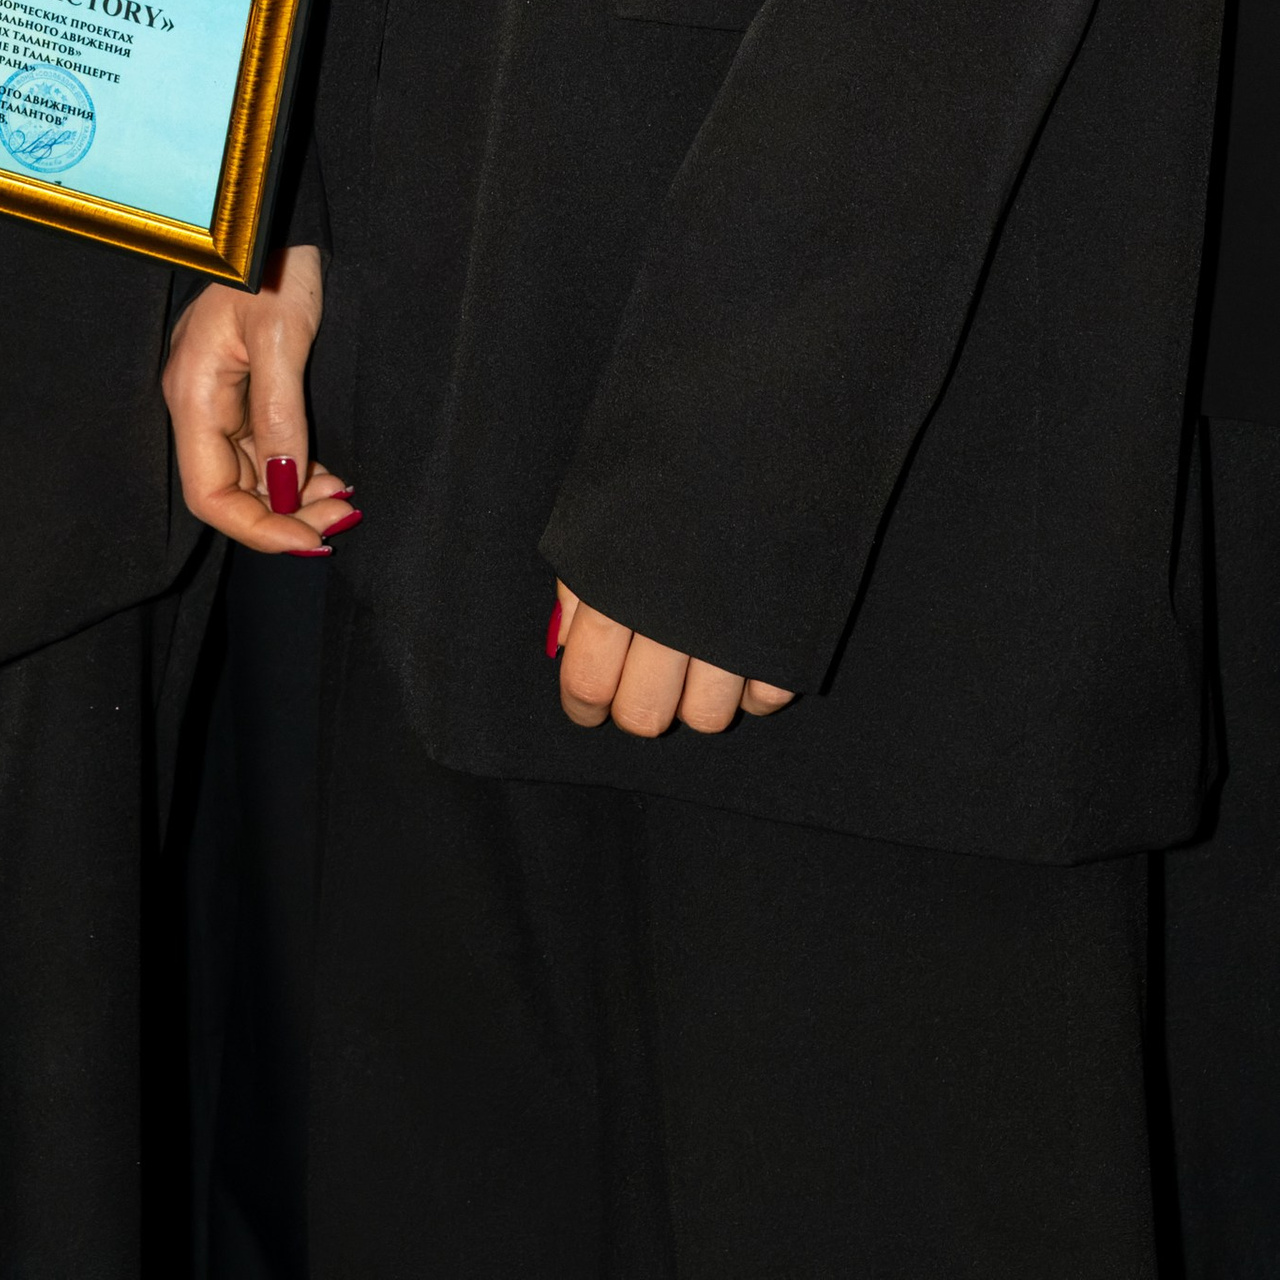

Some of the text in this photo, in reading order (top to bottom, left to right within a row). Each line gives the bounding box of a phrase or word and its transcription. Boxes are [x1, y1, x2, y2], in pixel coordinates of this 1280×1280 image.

[12, 30, 82, 57] ТАЛАНТОВ»
[60, 30, 131, 58] ДВИЖЕНИЯ
[70, 18, 134, 45] ПРОЕКТАХ
[12, 42, 20, 55] В
[22, 47, 121, 84] ГАЛА-КОНЦЕРТЕ
[24, 93, 94, 121] ДВИЖЕНИЯ
